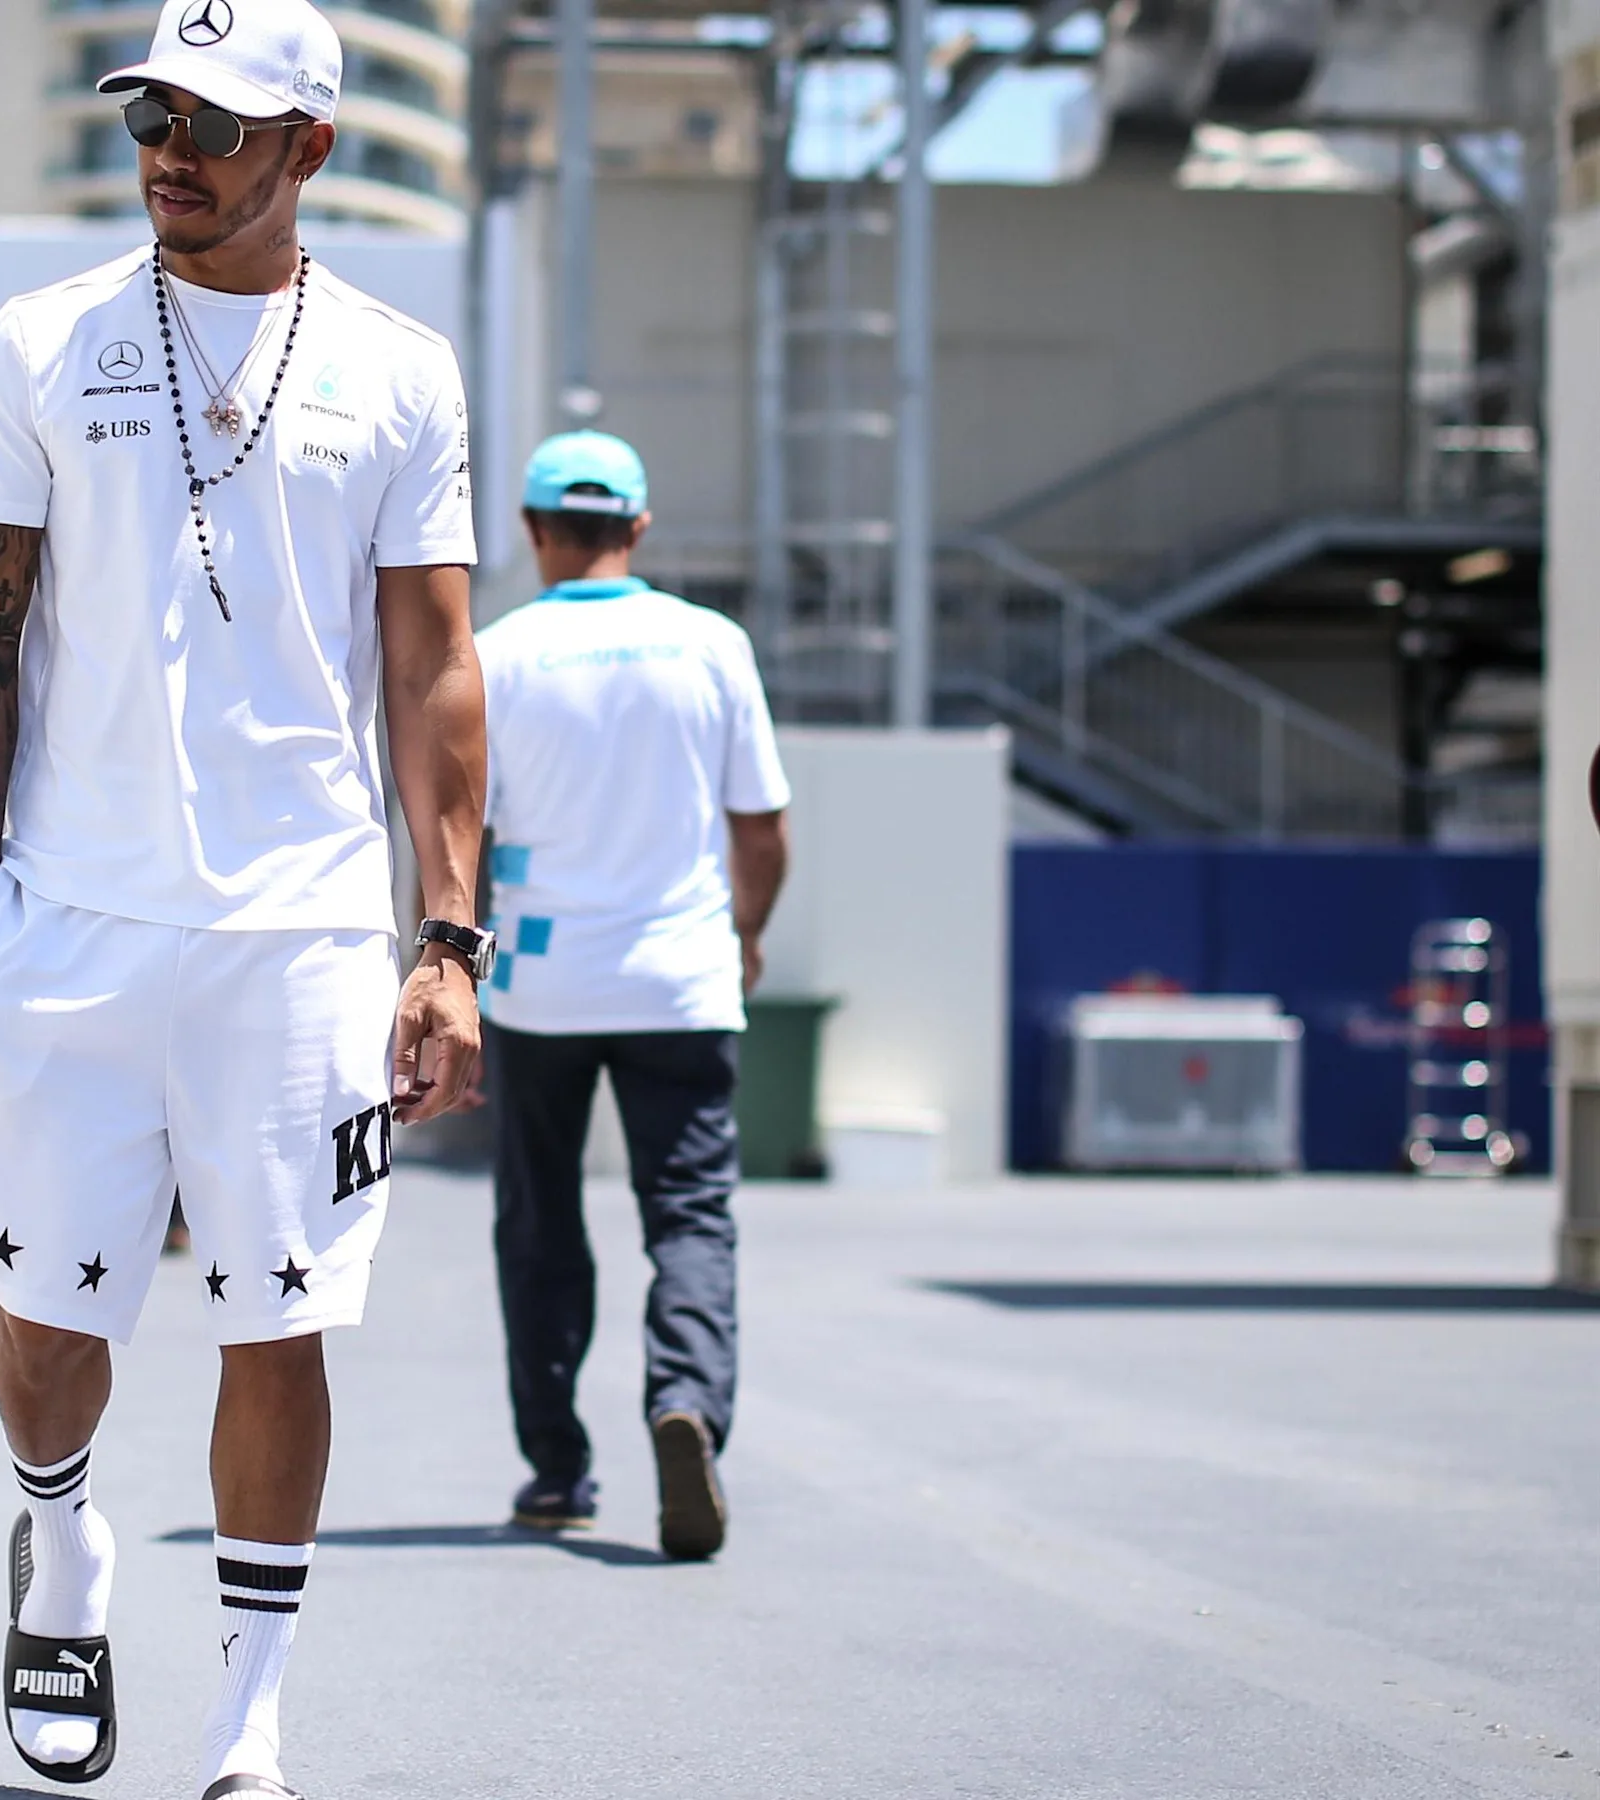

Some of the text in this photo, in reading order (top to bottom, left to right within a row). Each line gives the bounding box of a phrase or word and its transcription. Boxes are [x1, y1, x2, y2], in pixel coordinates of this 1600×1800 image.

[300, 402, 356, 422] PETRONAS
[110, 419, 151, 438] UBS
[303, 442, 348, 466] BOSS
[13, 1668, 86, 1698] PUMA
